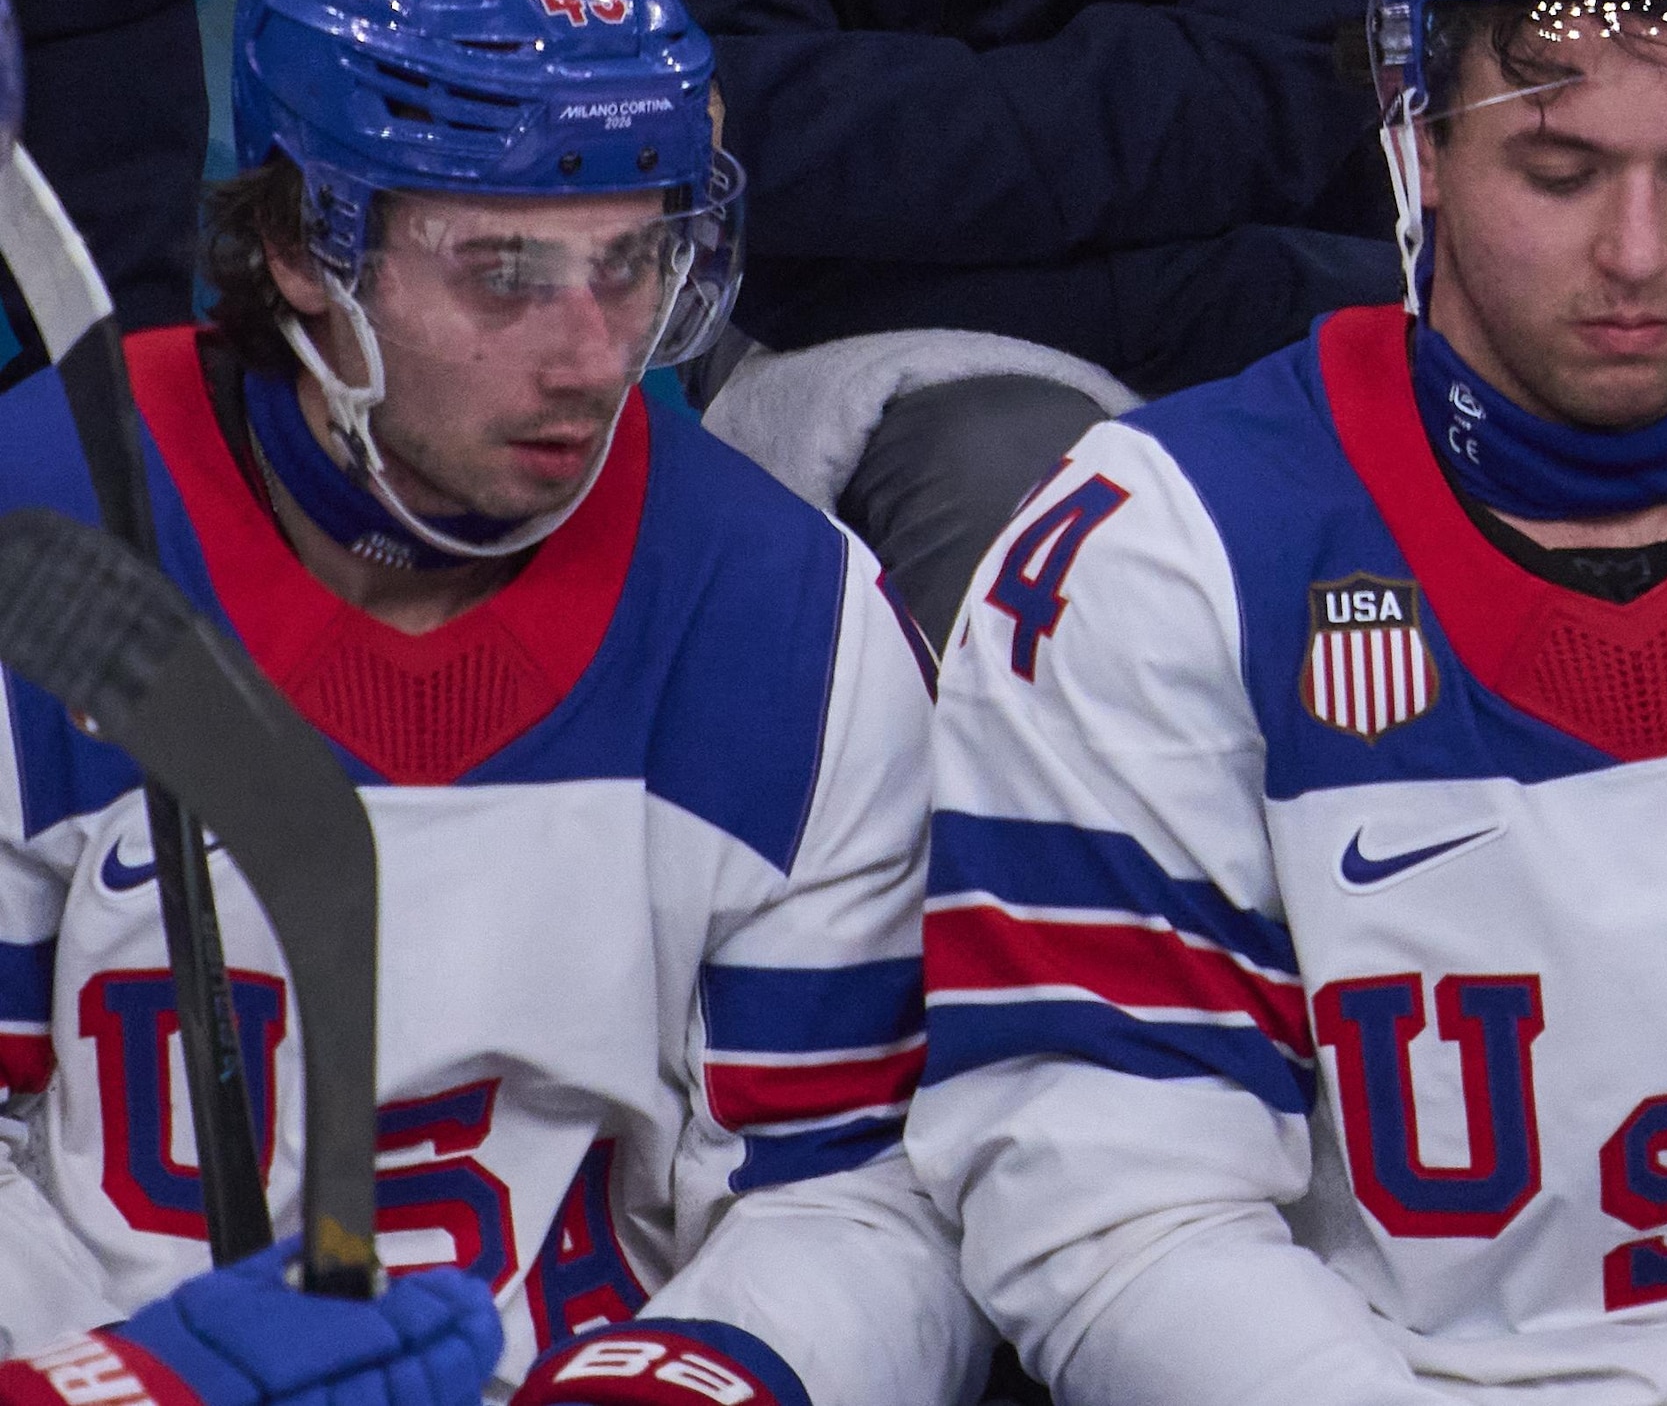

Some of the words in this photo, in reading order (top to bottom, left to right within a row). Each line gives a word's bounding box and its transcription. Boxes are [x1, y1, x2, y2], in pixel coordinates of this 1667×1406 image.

[559, 102, 619, 121] MILANO
[619, 98, 674, 116] CORTINA
[604, 115, 632, 131] 2026
[965, 456, 1133, 685] 4
[1325, 589, 1403, 624] USA
